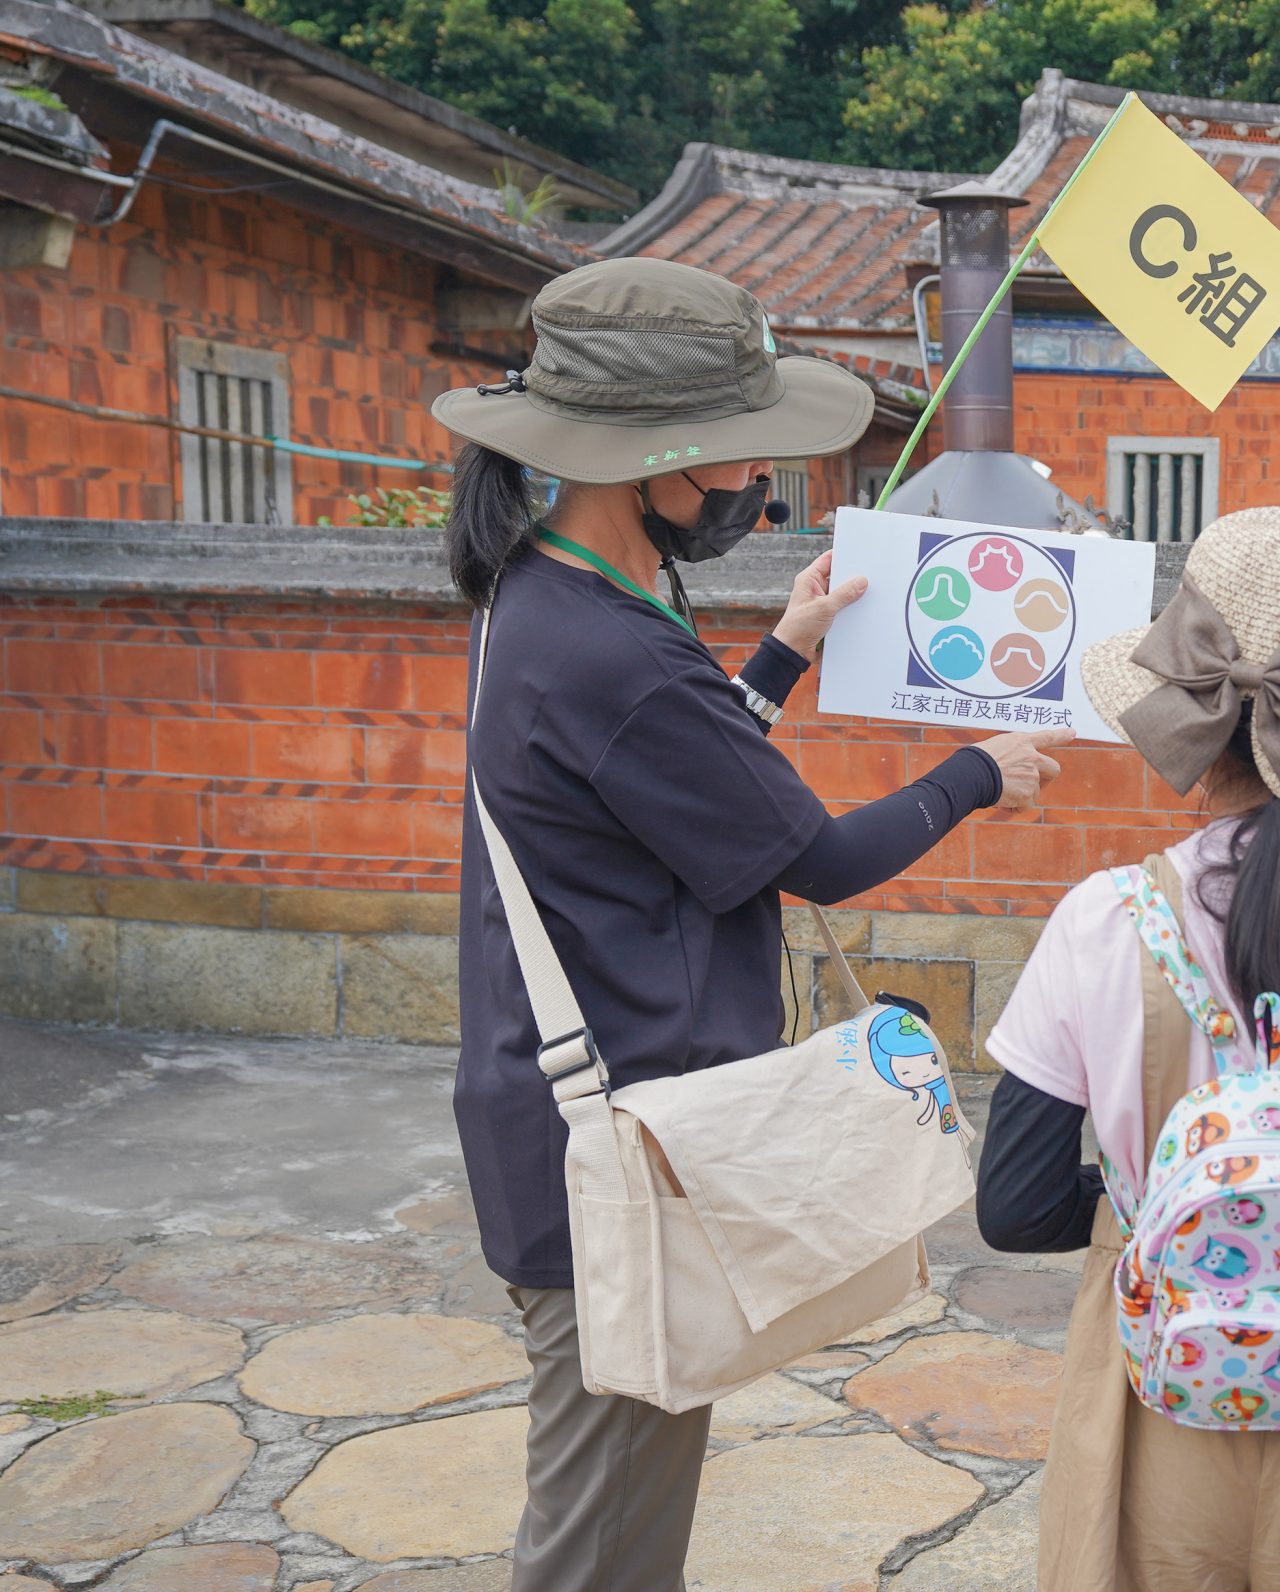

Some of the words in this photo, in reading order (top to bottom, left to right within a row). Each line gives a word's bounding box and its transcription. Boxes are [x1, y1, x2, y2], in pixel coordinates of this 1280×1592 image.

[1129, 204, 1267, 348] C組
[891, 691, 1072, 728] 江家古厝及馬背形式
